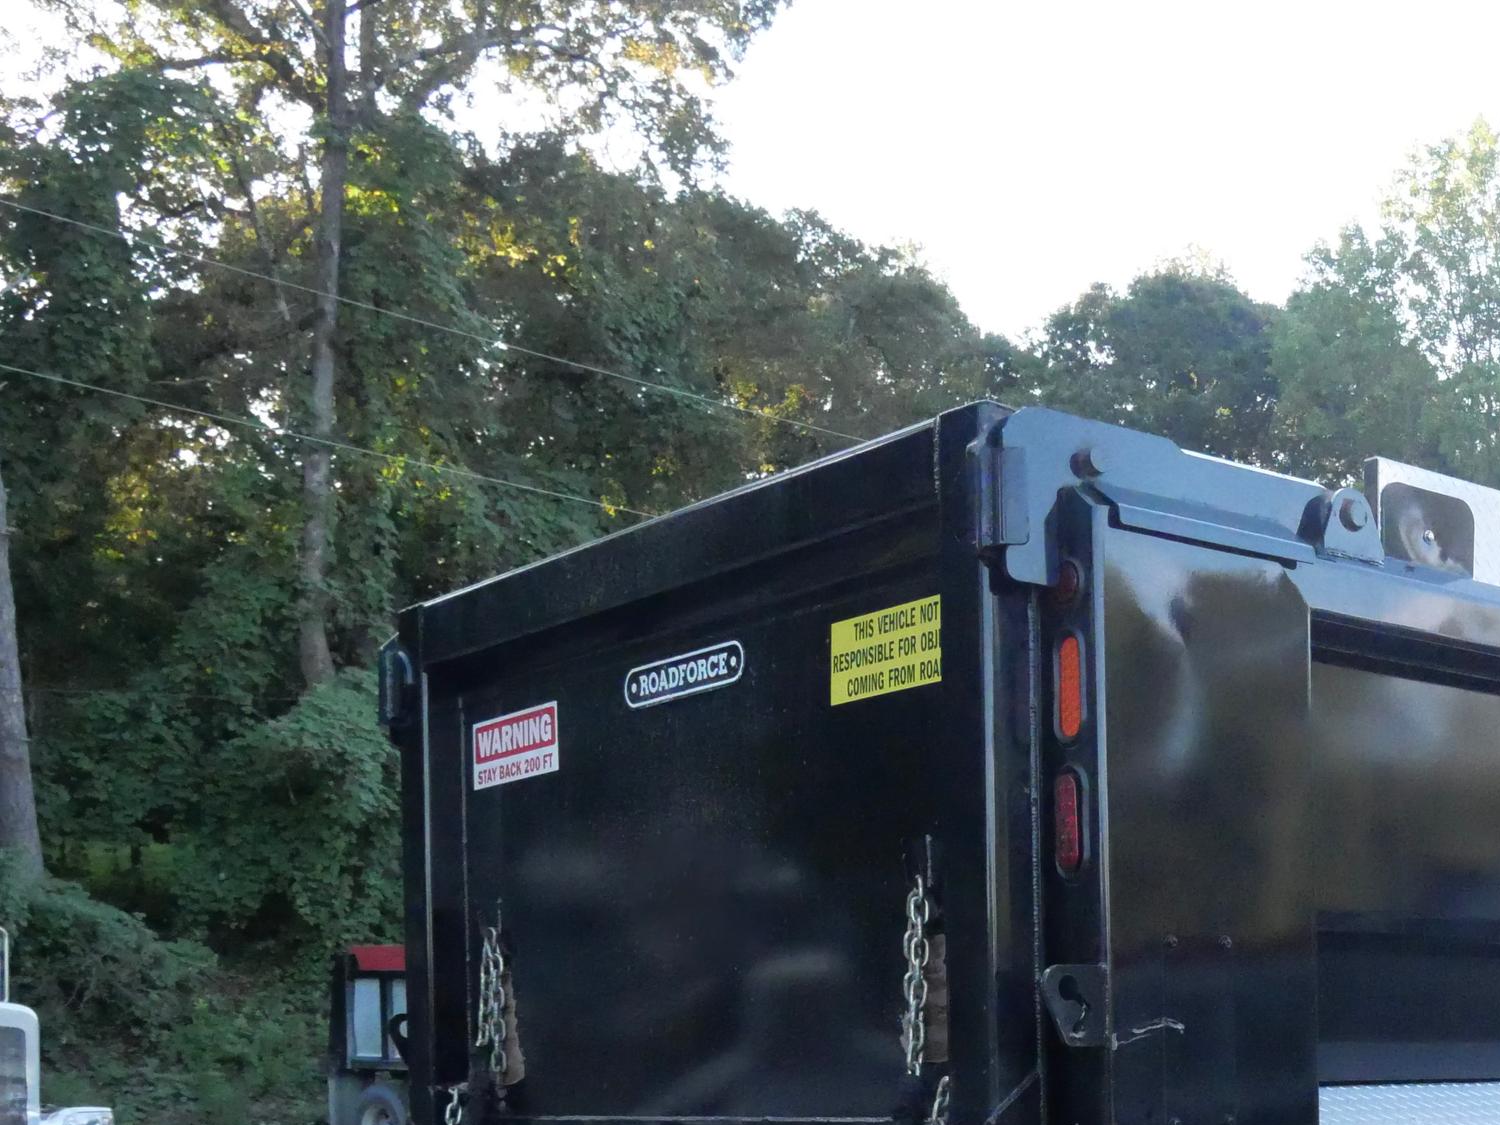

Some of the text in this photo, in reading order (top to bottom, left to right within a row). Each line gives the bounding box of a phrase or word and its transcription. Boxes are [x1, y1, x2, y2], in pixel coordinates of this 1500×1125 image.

[854, 601, 939, 642] THIS VEHICLE NOT
[639, 652, 728, 696] ROADFORCE
[833, 641, 895, 674] RESPONSIBLE
[898, 635, 917, 658] FOR
[847, 658, 941, 697] COMING FROM ROA
[478, 713, 552, 758] WARNING
[478, 752, 553, 785] STAY BACK 200 FT
